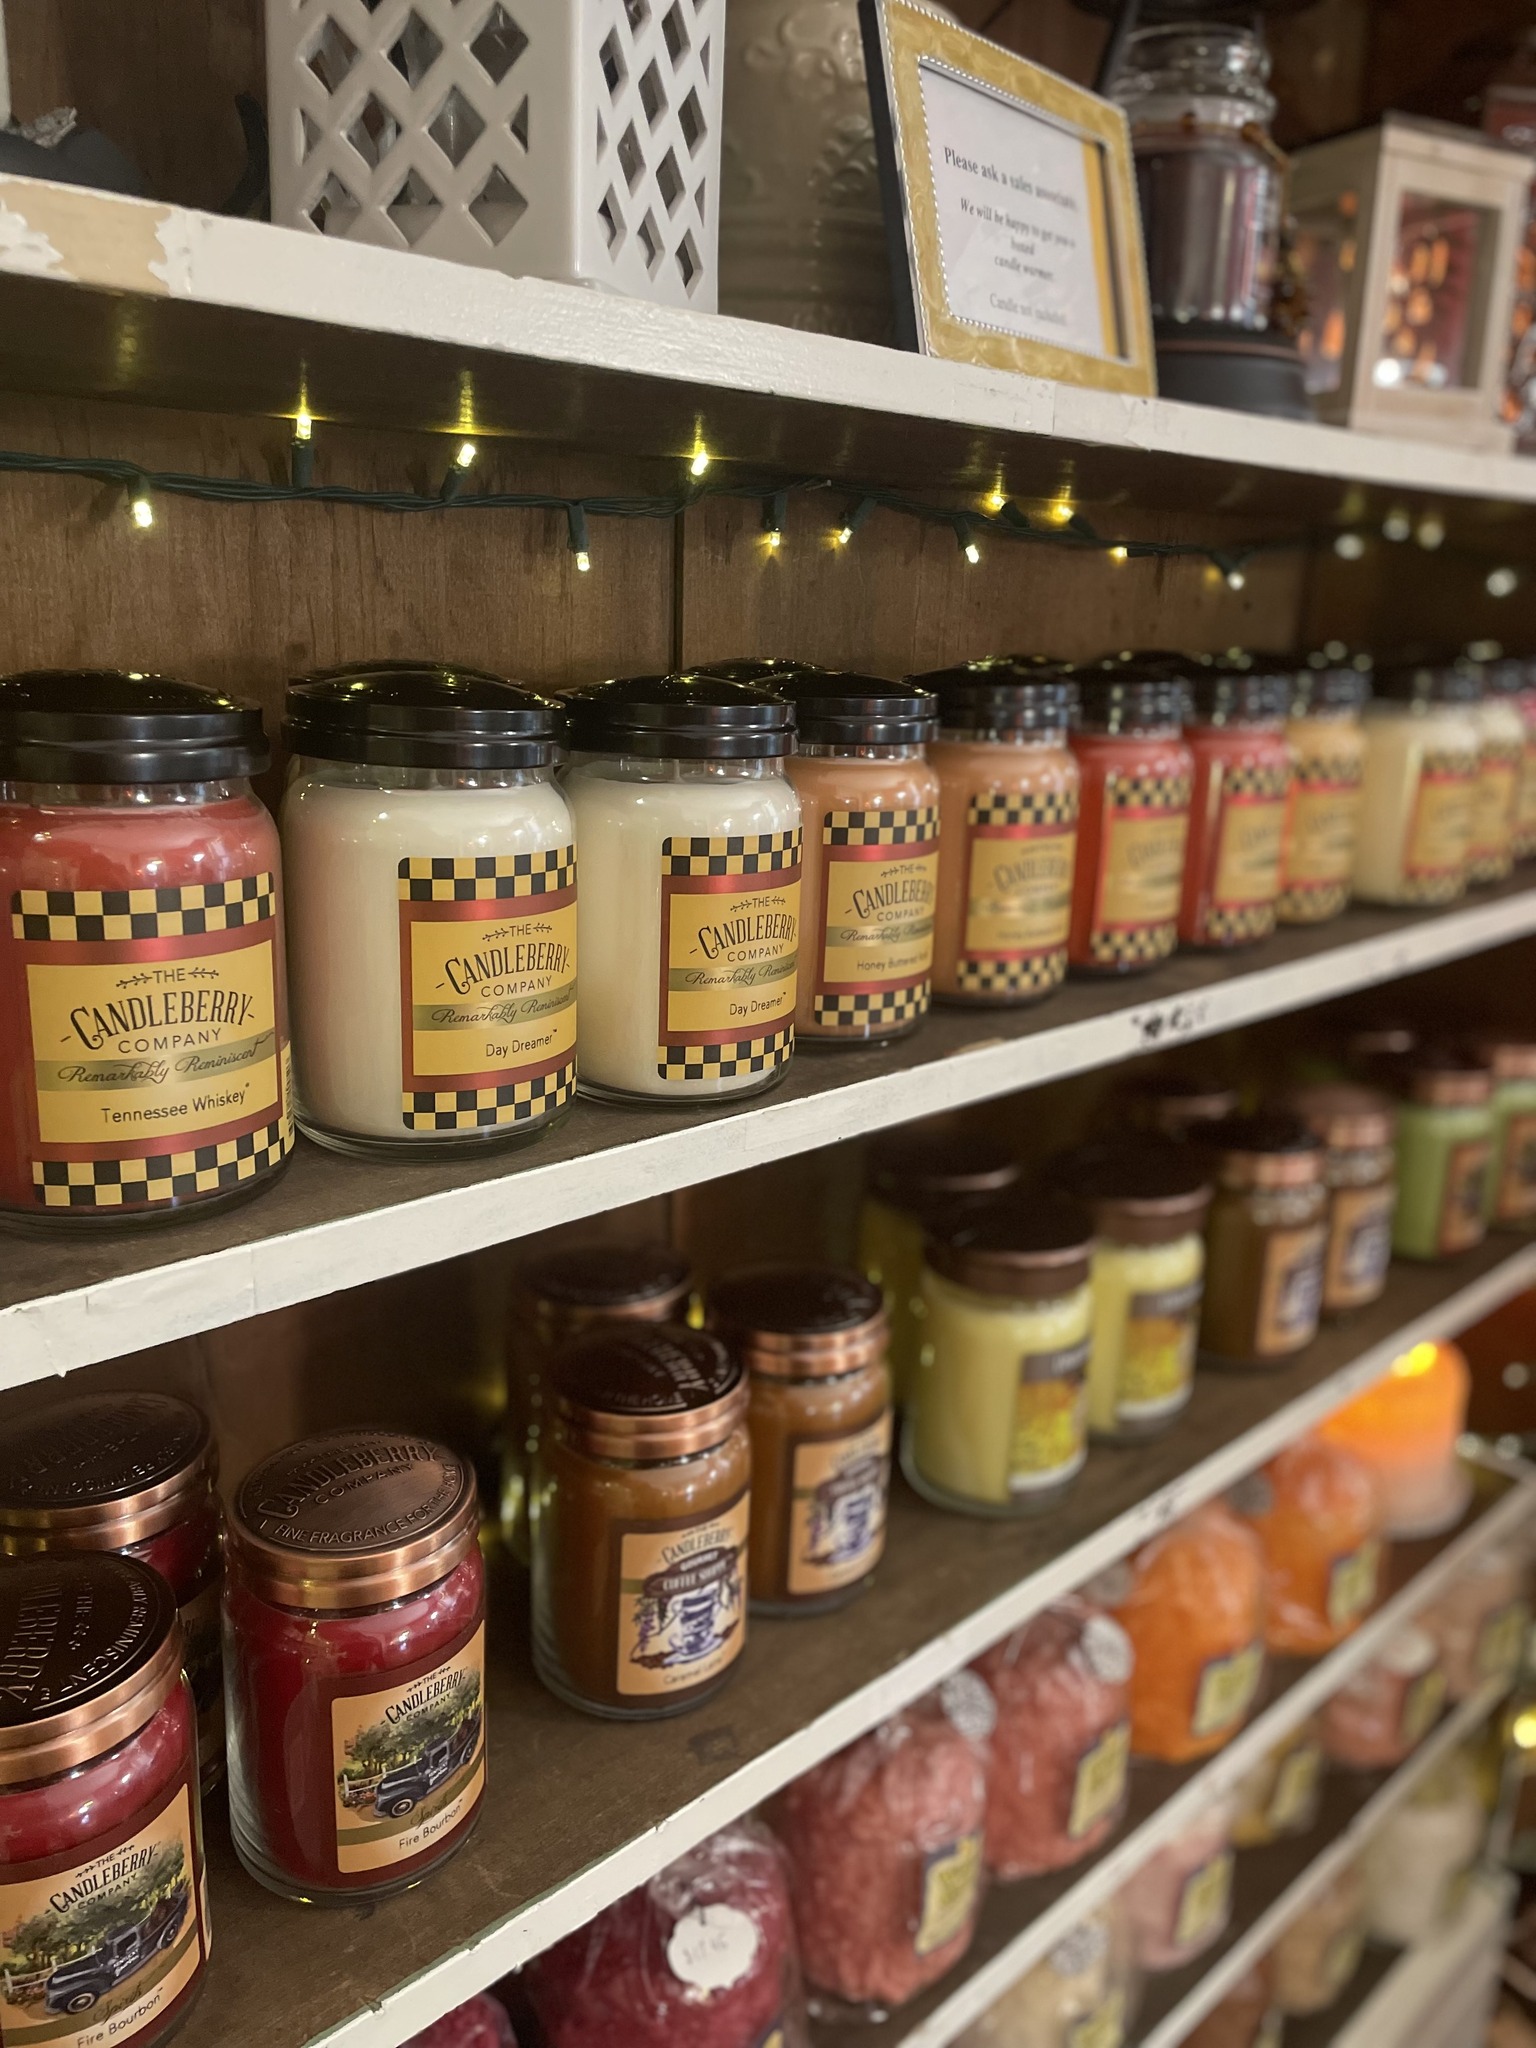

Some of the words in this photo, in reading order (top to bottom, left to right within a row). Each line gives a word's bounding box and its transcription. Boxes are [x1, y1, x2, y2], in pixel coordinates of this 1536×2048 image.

[944, 146, 978, 175] Please
[981, 164, 999, 182] ask
[1001, 172, 1008, 185] a
[960, 198, 974, 216] We
[976, 204, 992, 220] will
[994, 209, 1004, 225] be
[994, 256, 1021, 273] candle
[990, 293, 1018, 314] Candle
[900, 864, 914, 875] THE
[751, 896, 771, 909] THE
[509, 923, 532, 937] THE
[698, 913, 797, 960] CANDLEBERRY
[727, 944, 785, 963] COMPANY
[153, 968, 186, 984] THE
[444, 942, 571, 995] CANDLEBERRY
[685, 968, 757, 987] Remarkably
[857, 960, 886, 973] Honey
[481, 975, 553, 998] COMPANY
[70, 990, 253, 1050] CANDLEBERRY
[431, 1003, 518, 1025] Remarkably
[729, 1003, 749, 1018] Day
[118, 1027, 222, 1054] COMPANY
[486, 1043, 508, 1059] Day
[57, 1060, 171, 1085] Remarkably
[174, 1031, 275, 1074] Reminiscent
[101, 1103, 188, 1124] Tennessee
[257, 1444, 439, 1519] CANDLEBERRY
[315, 1463, 414, 1505] COMPANY
[275, 1523, 310, 1542] FINE
[309, 1518, 408, 1544] FRAGRANCE
[407, 1504, 433, 1525] FOR
[662, 1572, 697, 1592] COFFEE
[422, 1673, 437, 1685] THE
[385, 1670, 466, 1725] CANDLEBERRY
[406, 1693, 452, 1722] COMPANY
[399, 1834, 419, 1849] Fire
[422, 1804, 461, 1838] Bourbon
[96, 1853, 115, 1867] THE
[50, 1845, 156, 1914] CANDLEBERRY
[78, 1873, 137, 1910] COMPANY
[77, 2032, 104, 2048] Fire
[109, 1994, 160, 2035] Bourbon
